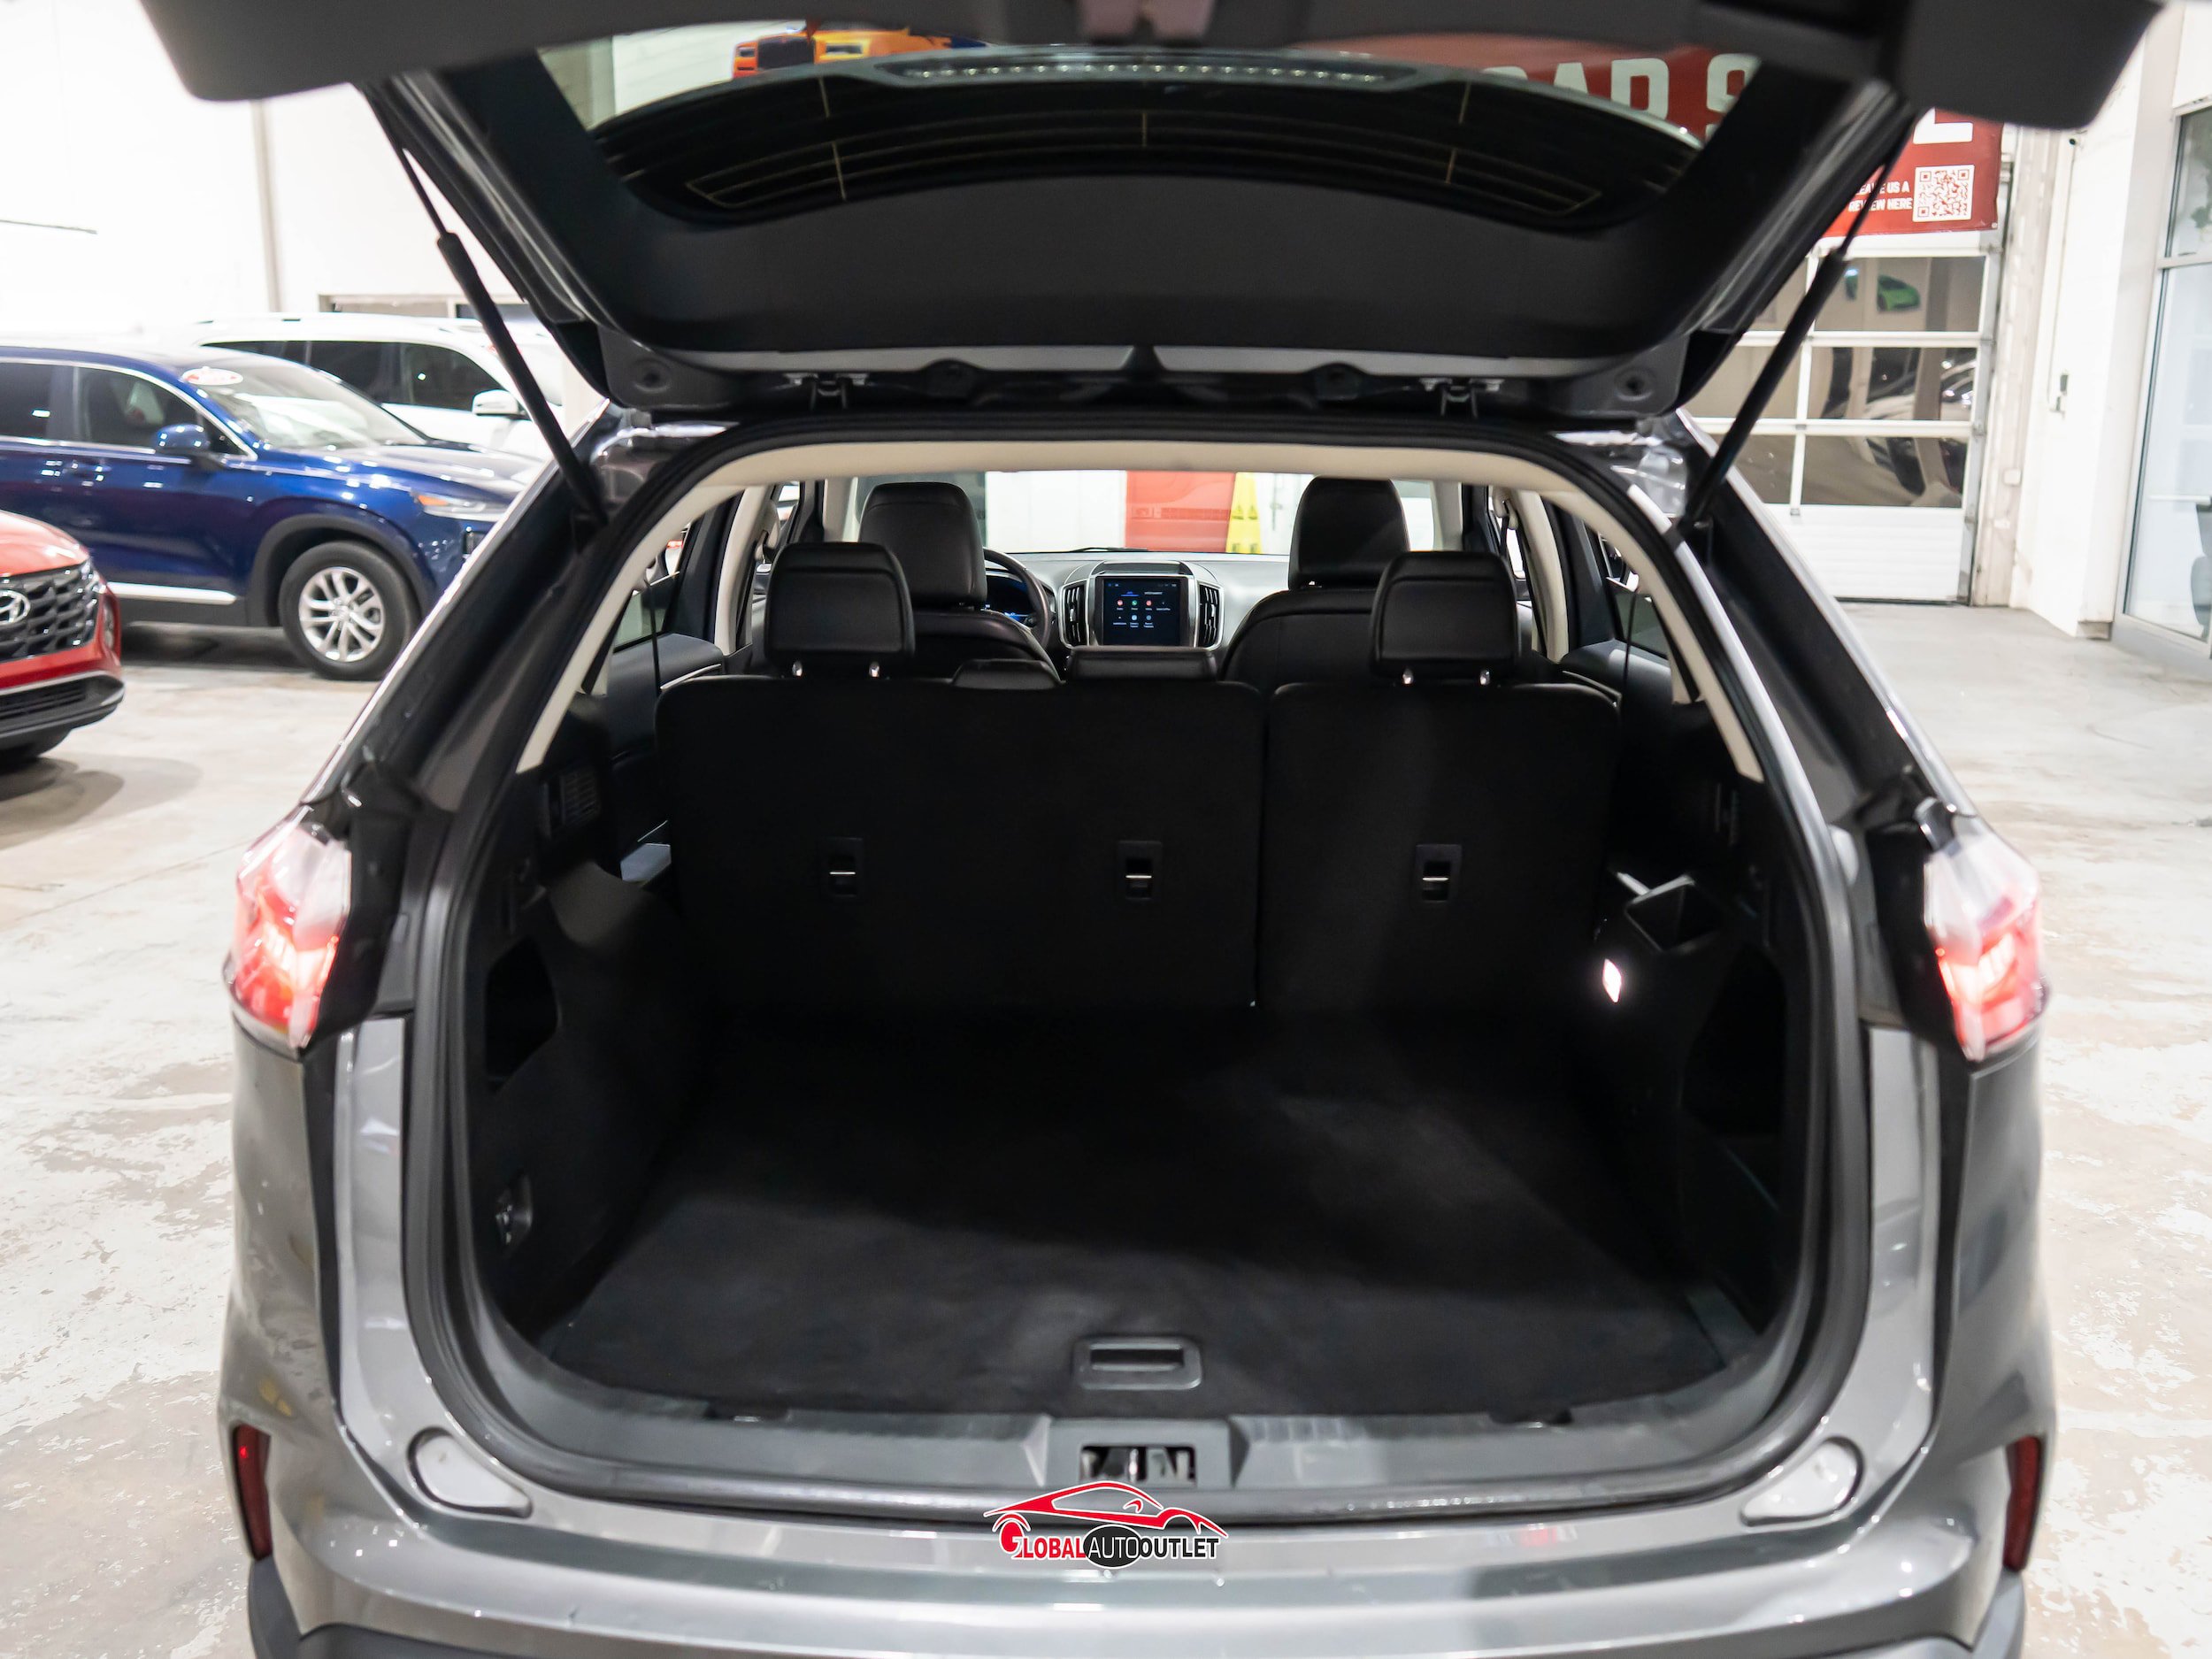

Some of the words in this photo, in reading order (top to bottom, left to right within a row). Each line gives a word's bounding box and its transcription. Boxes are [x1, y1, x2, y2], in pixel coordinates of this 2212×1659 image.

[1886, 180, 1901, 194] US
[1901, 180, 1910, 193] A
[1886, 197, 1913, 211] HERE
